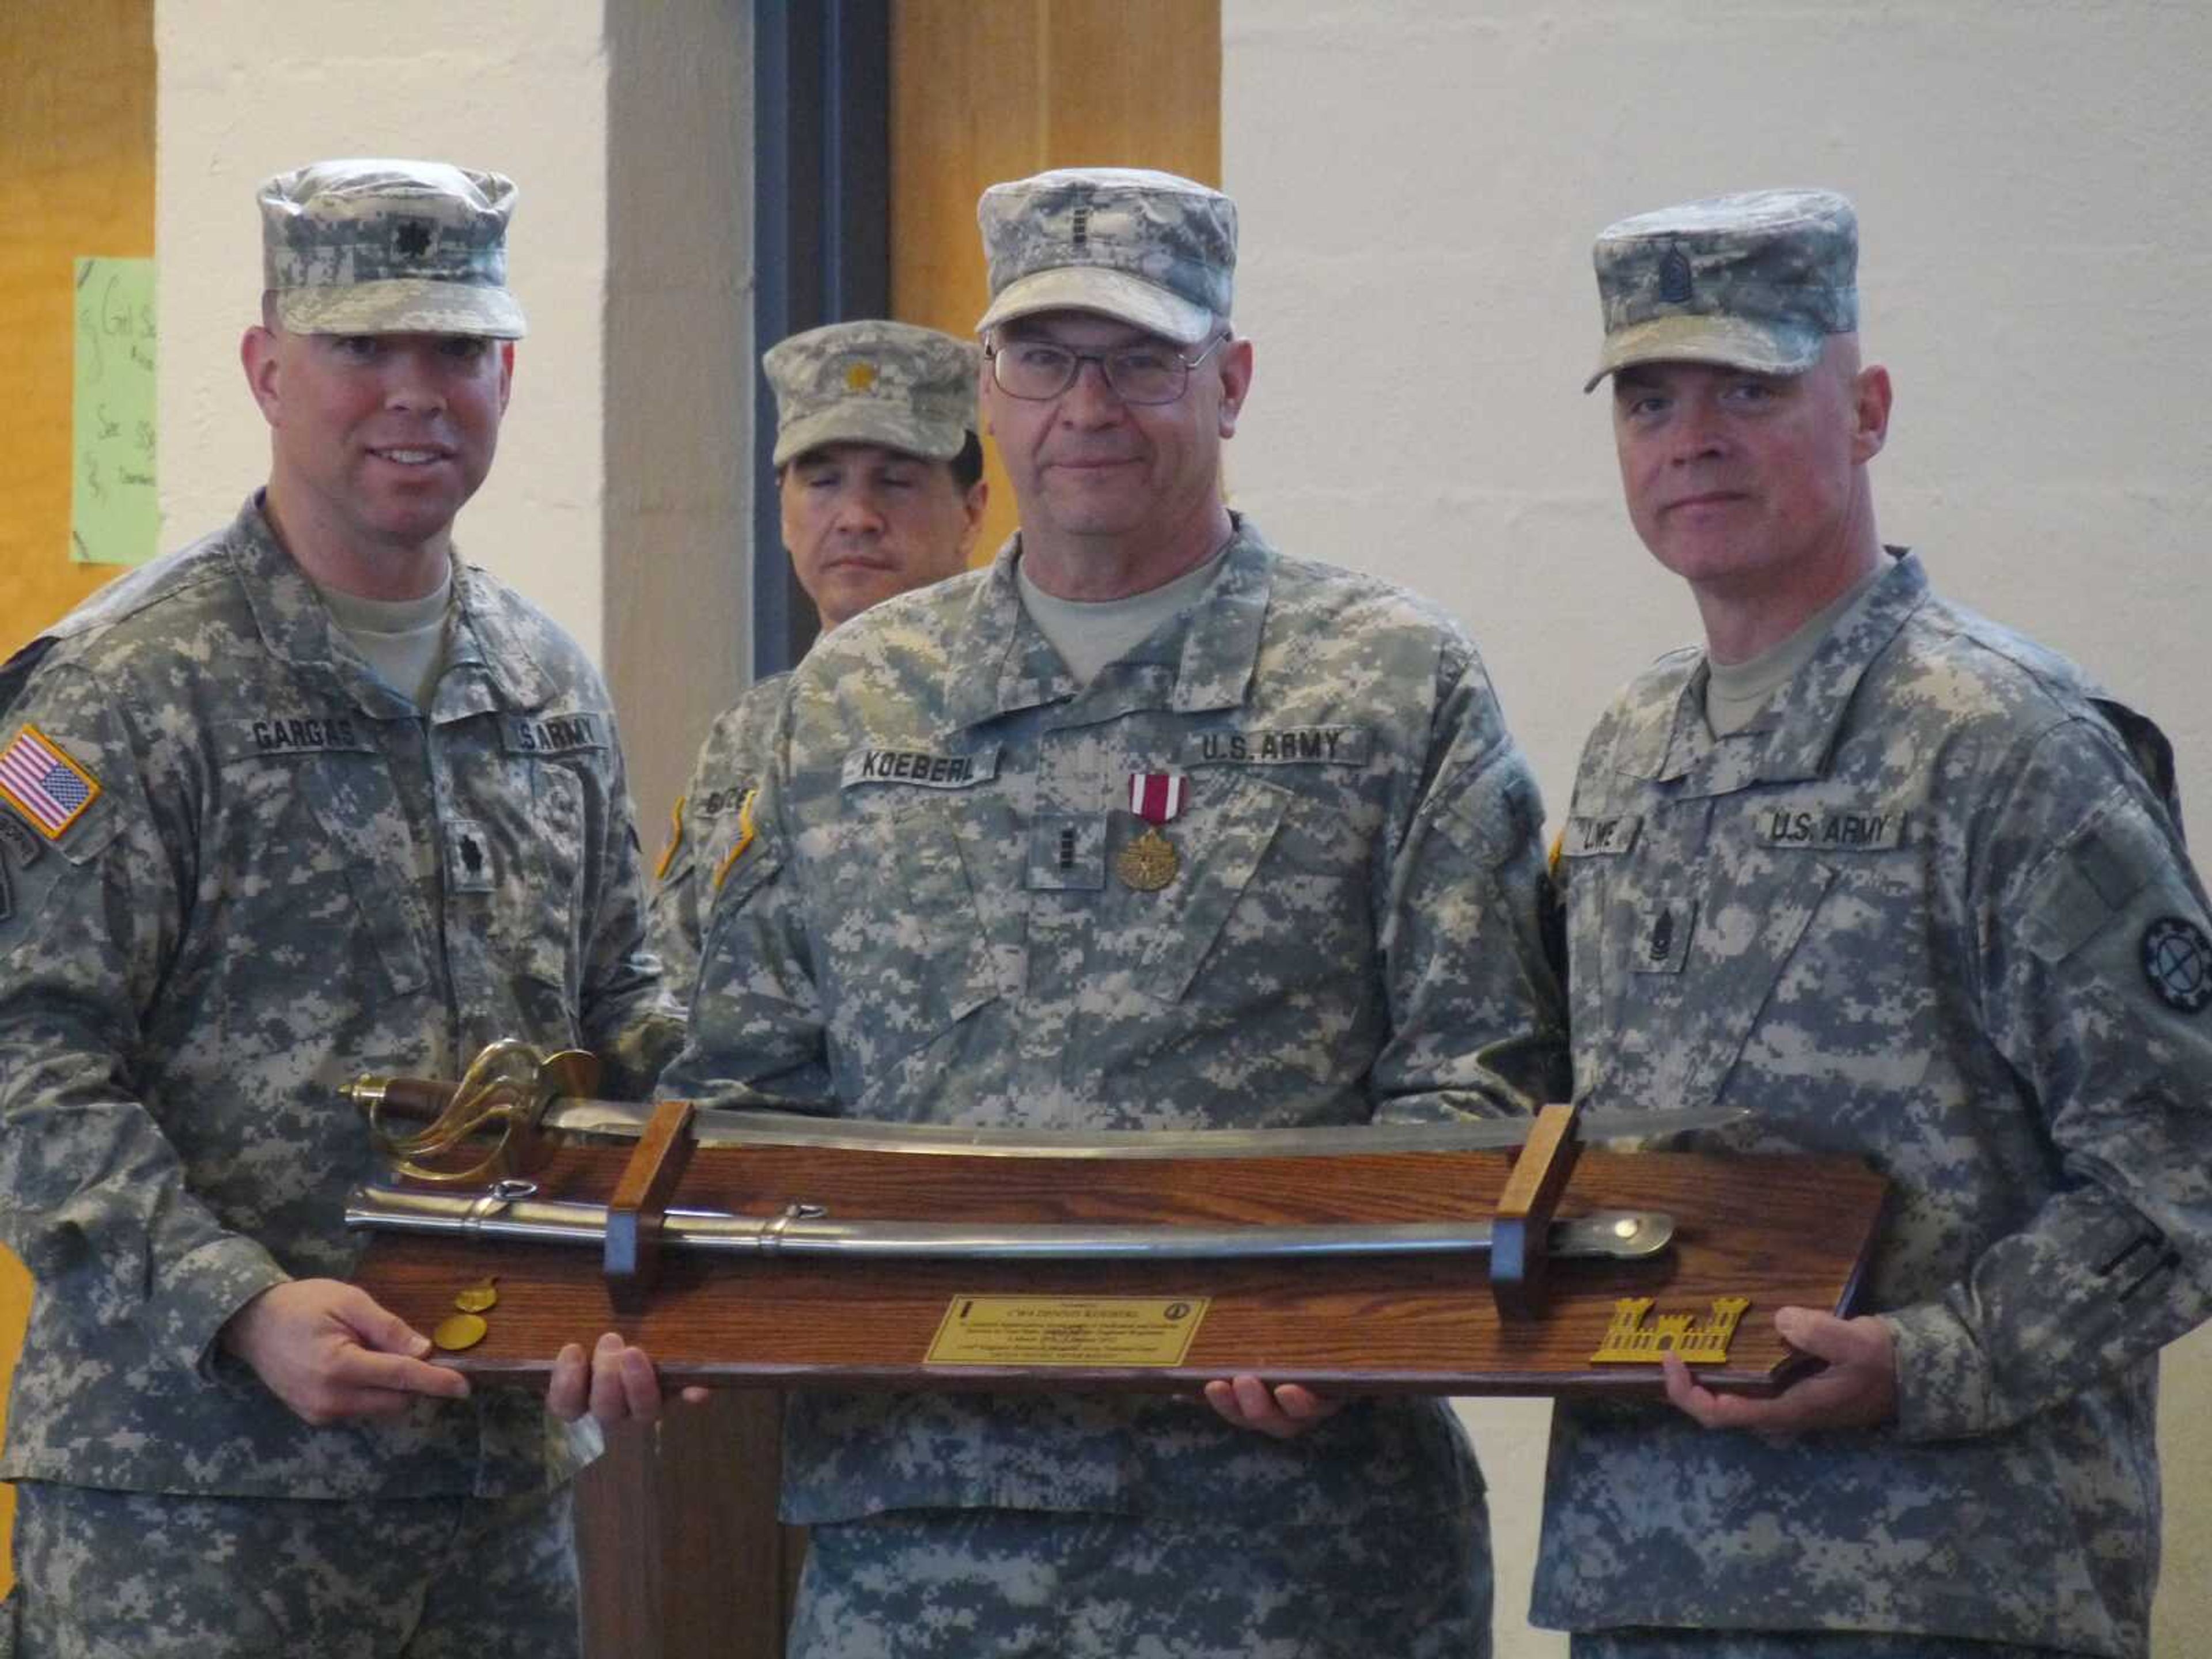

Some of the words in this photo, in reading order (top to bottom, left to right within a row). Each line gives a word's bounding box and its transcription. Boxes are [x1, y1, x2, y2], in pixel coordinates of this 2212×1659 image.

[1203, 732, 1255, 760] U.S.
[1261, 729, 1342, 760] ARMY
[862, 751, 974, 783] KOEBERL
[1822, 814, 1890, 843] ARMY
